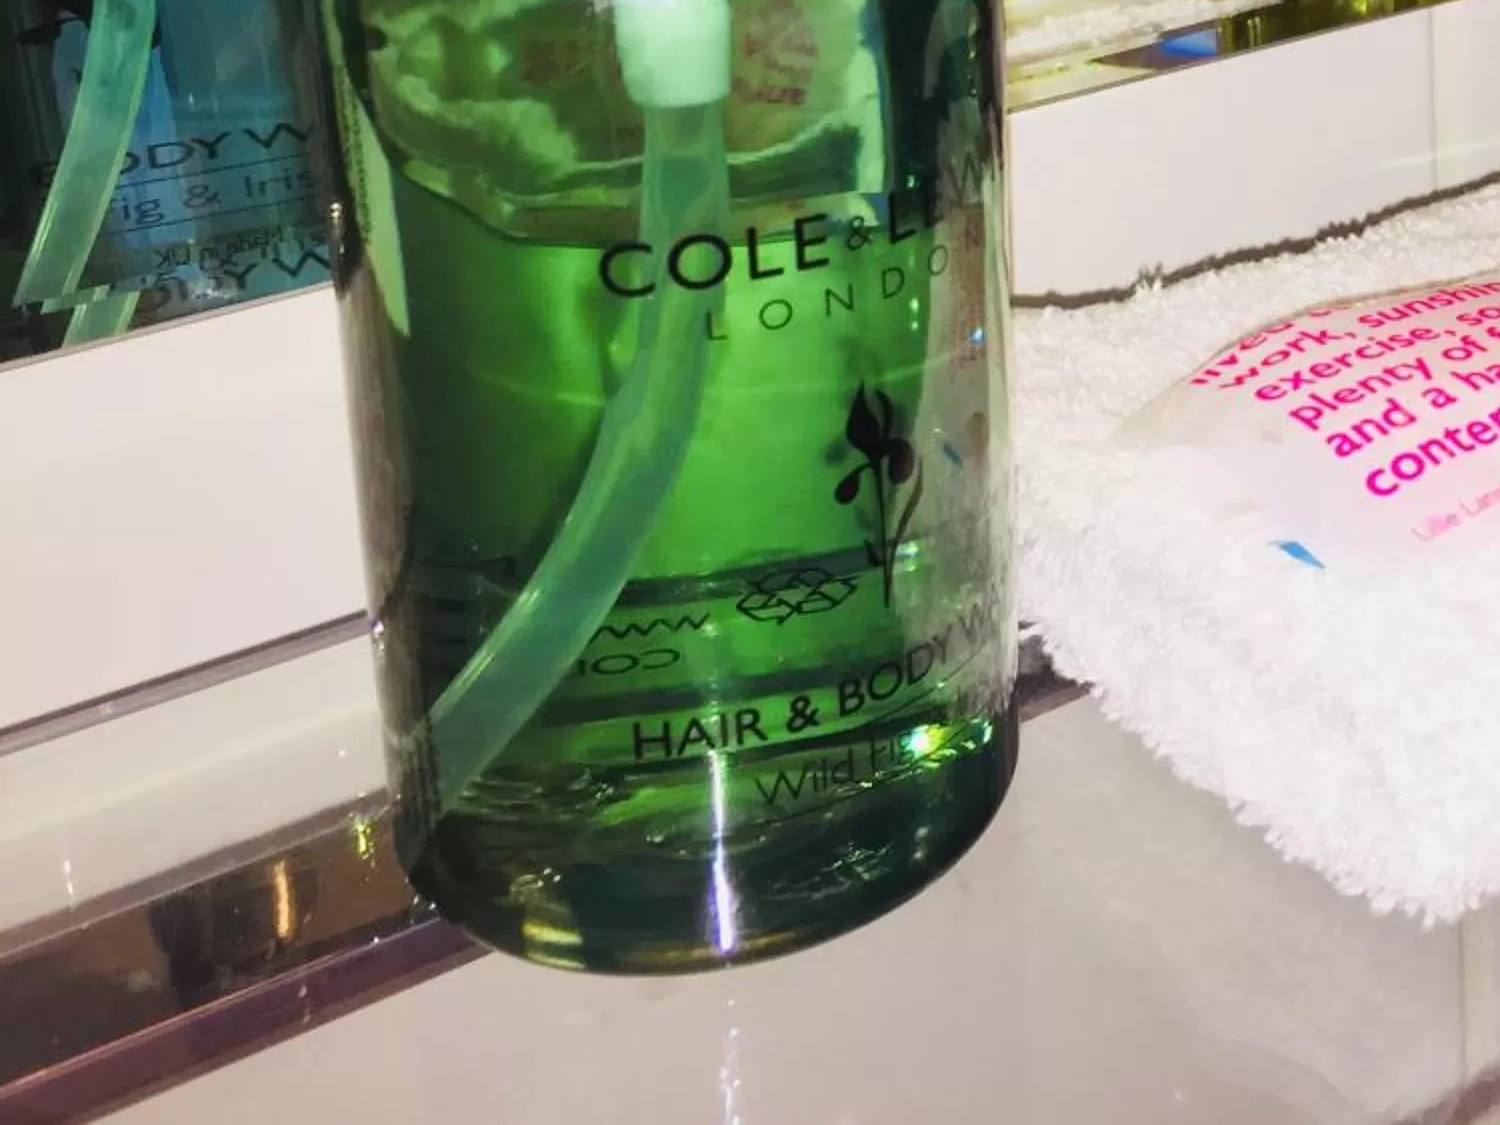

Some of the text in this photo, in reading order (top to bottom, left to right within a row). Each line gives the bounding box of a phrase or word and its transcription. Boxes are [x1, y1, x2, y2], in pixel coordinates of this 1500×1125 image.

[1253, 326, 1458, 402] exercise,
[1288, 356, 1435, 432] plenty
[1441, 334, 1489, 362] of
[1325, 397, 1418, 458] and
[1420, 386, 1458, 410] a
[632, 708, 769, 760] HAIR
[786, 694, 822, 734] &
[836, 622, 953, 718] BODY
